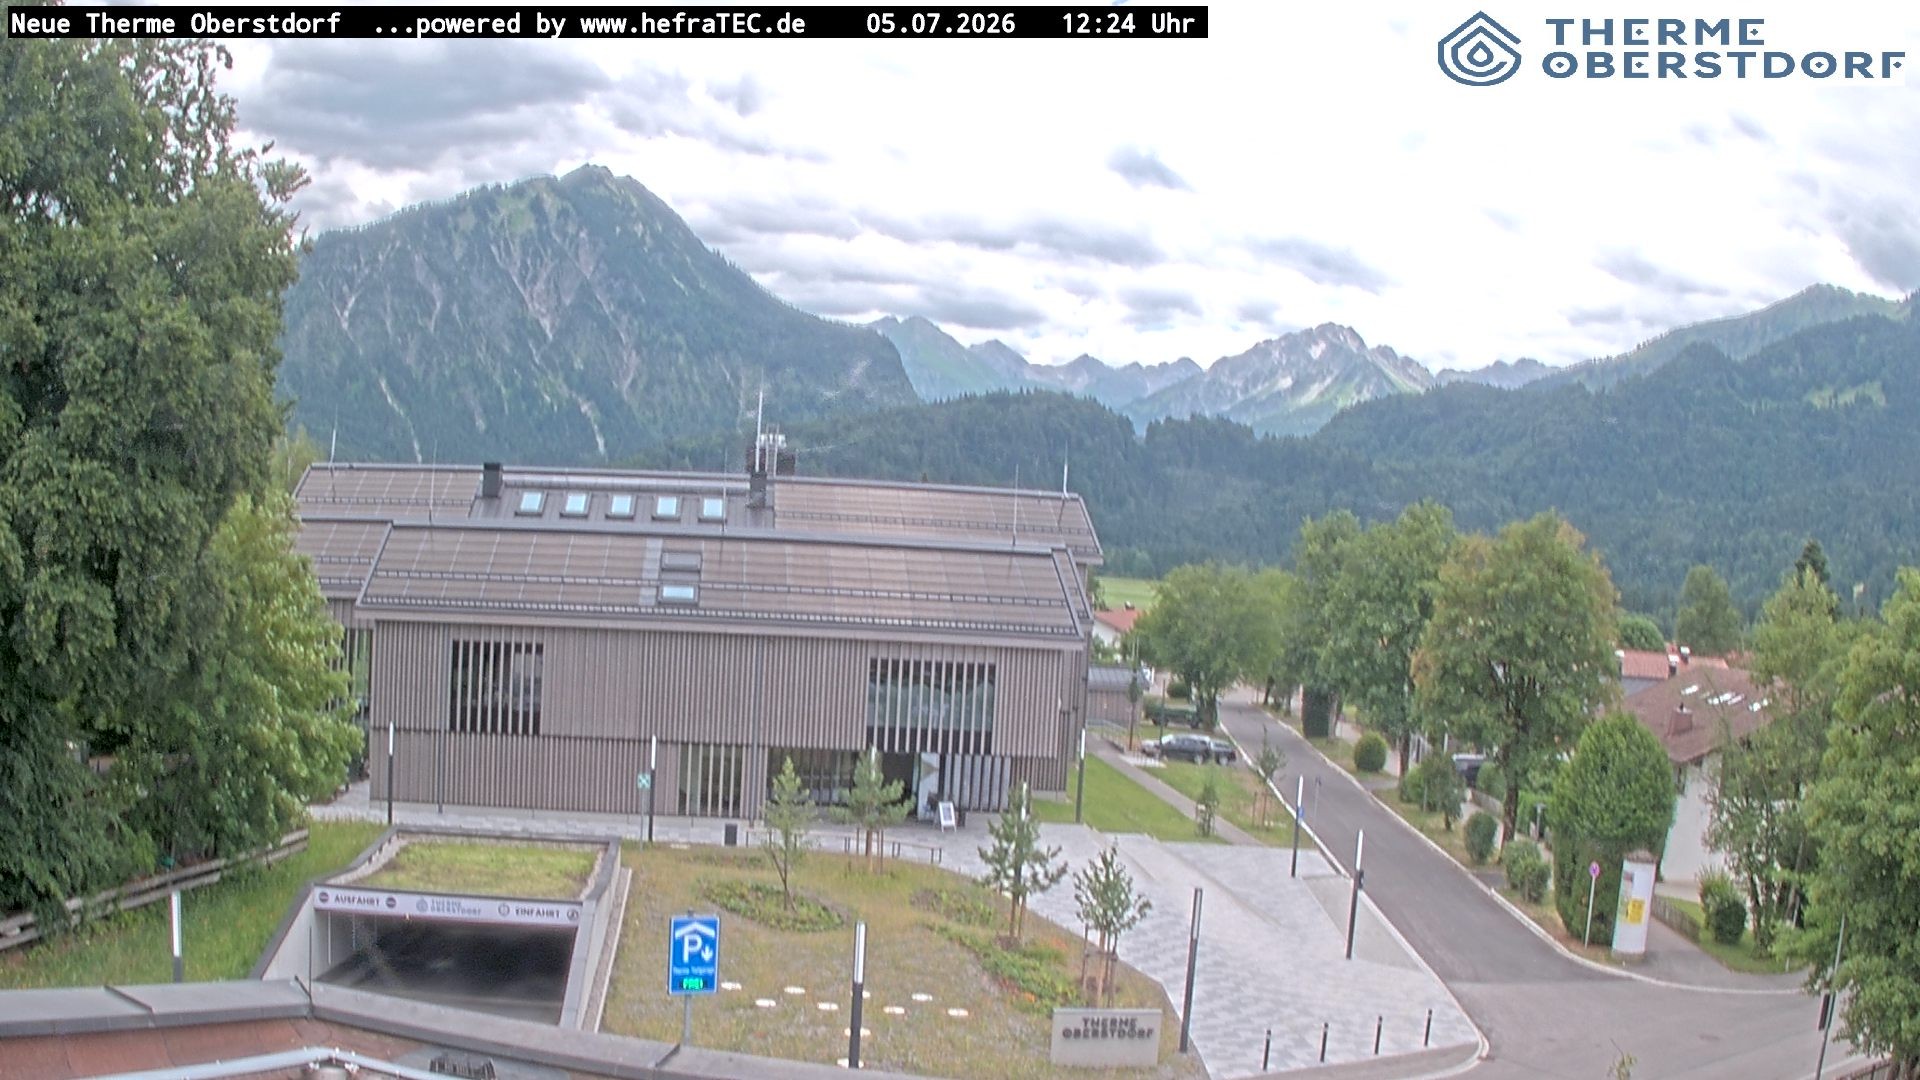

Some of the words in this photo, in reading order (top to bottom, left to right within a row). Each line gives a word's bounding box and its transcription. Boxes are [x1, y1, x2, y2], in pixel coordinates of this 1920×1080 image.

[334, 893, 380, 907] AUSFAHRT
[514, 906, 560, 919] EINFAHRT
[683, 934, 703, 963] P
[1081, 1016, 1138, 1029] THERME
[1061, 1027, 1154, 1040] OBERSTDORF
